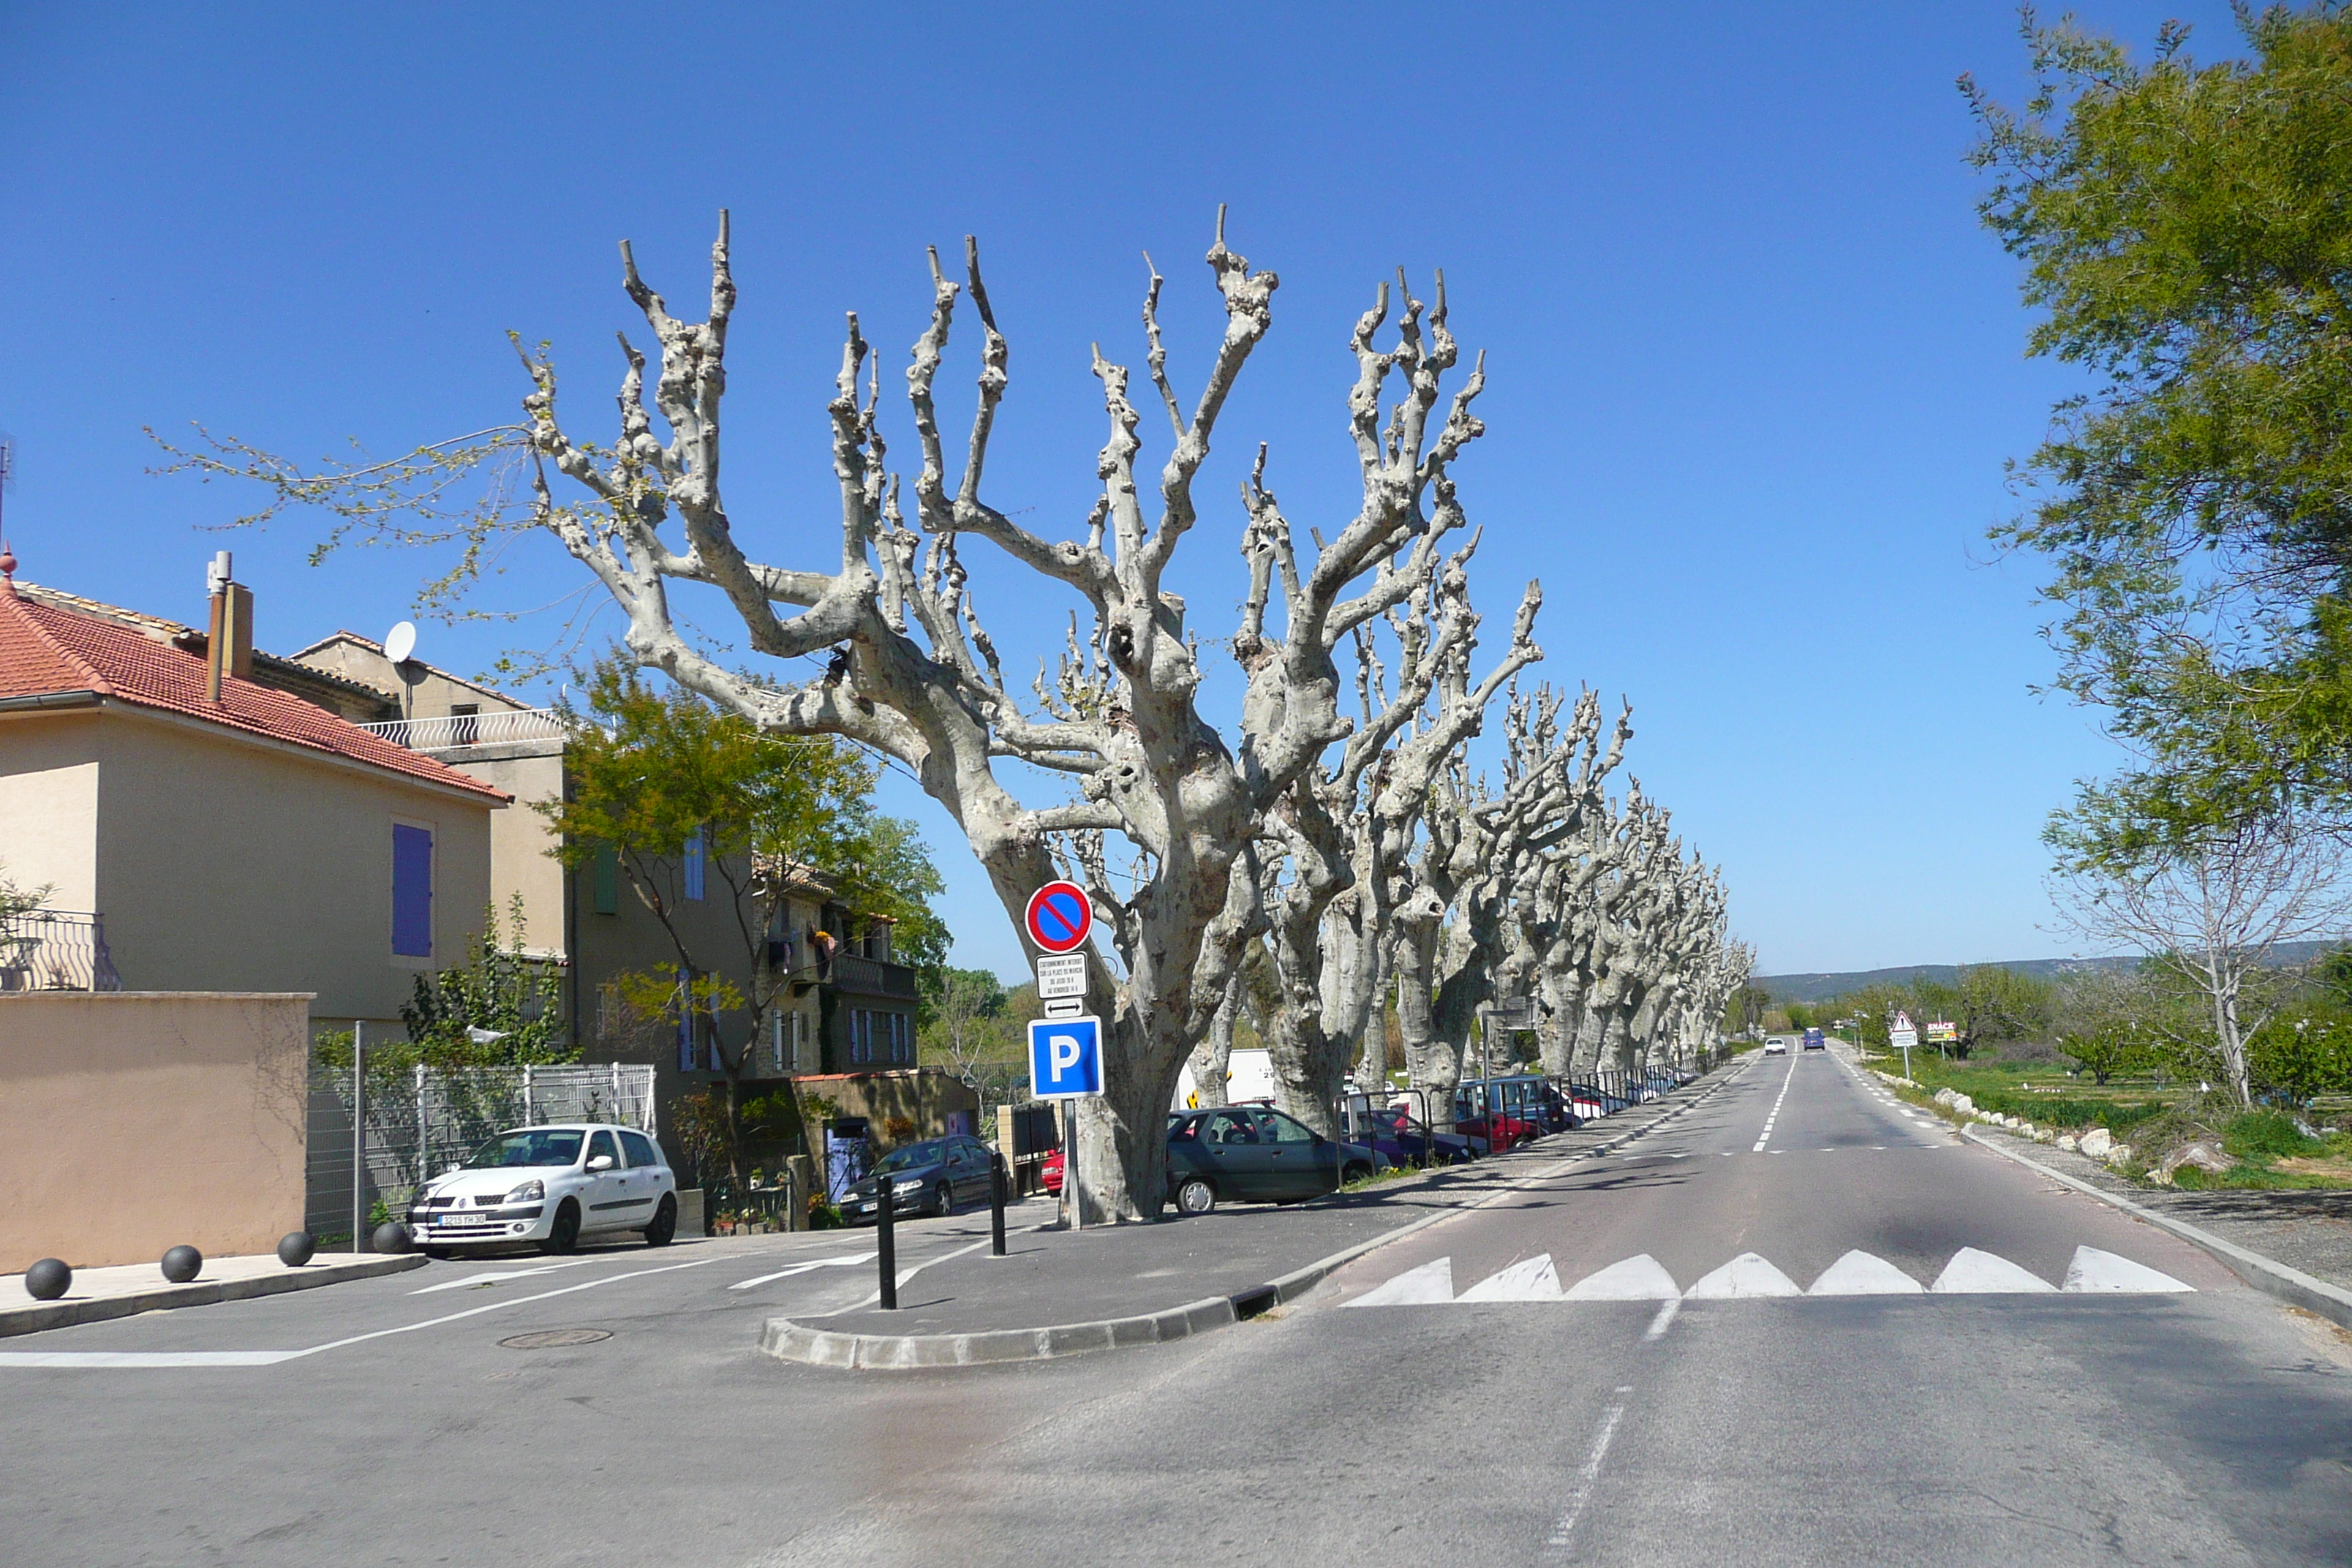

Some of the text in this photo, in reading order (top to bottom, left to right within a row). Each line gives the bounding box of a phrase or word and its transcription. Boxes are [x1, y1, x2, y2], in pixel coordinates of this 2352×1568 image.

[1927, 1022, 1954, 1030] SNACK
[1049, 1035, 1080, 1082] P
[444, 1215, 485, 1225] 3215 YH 30
